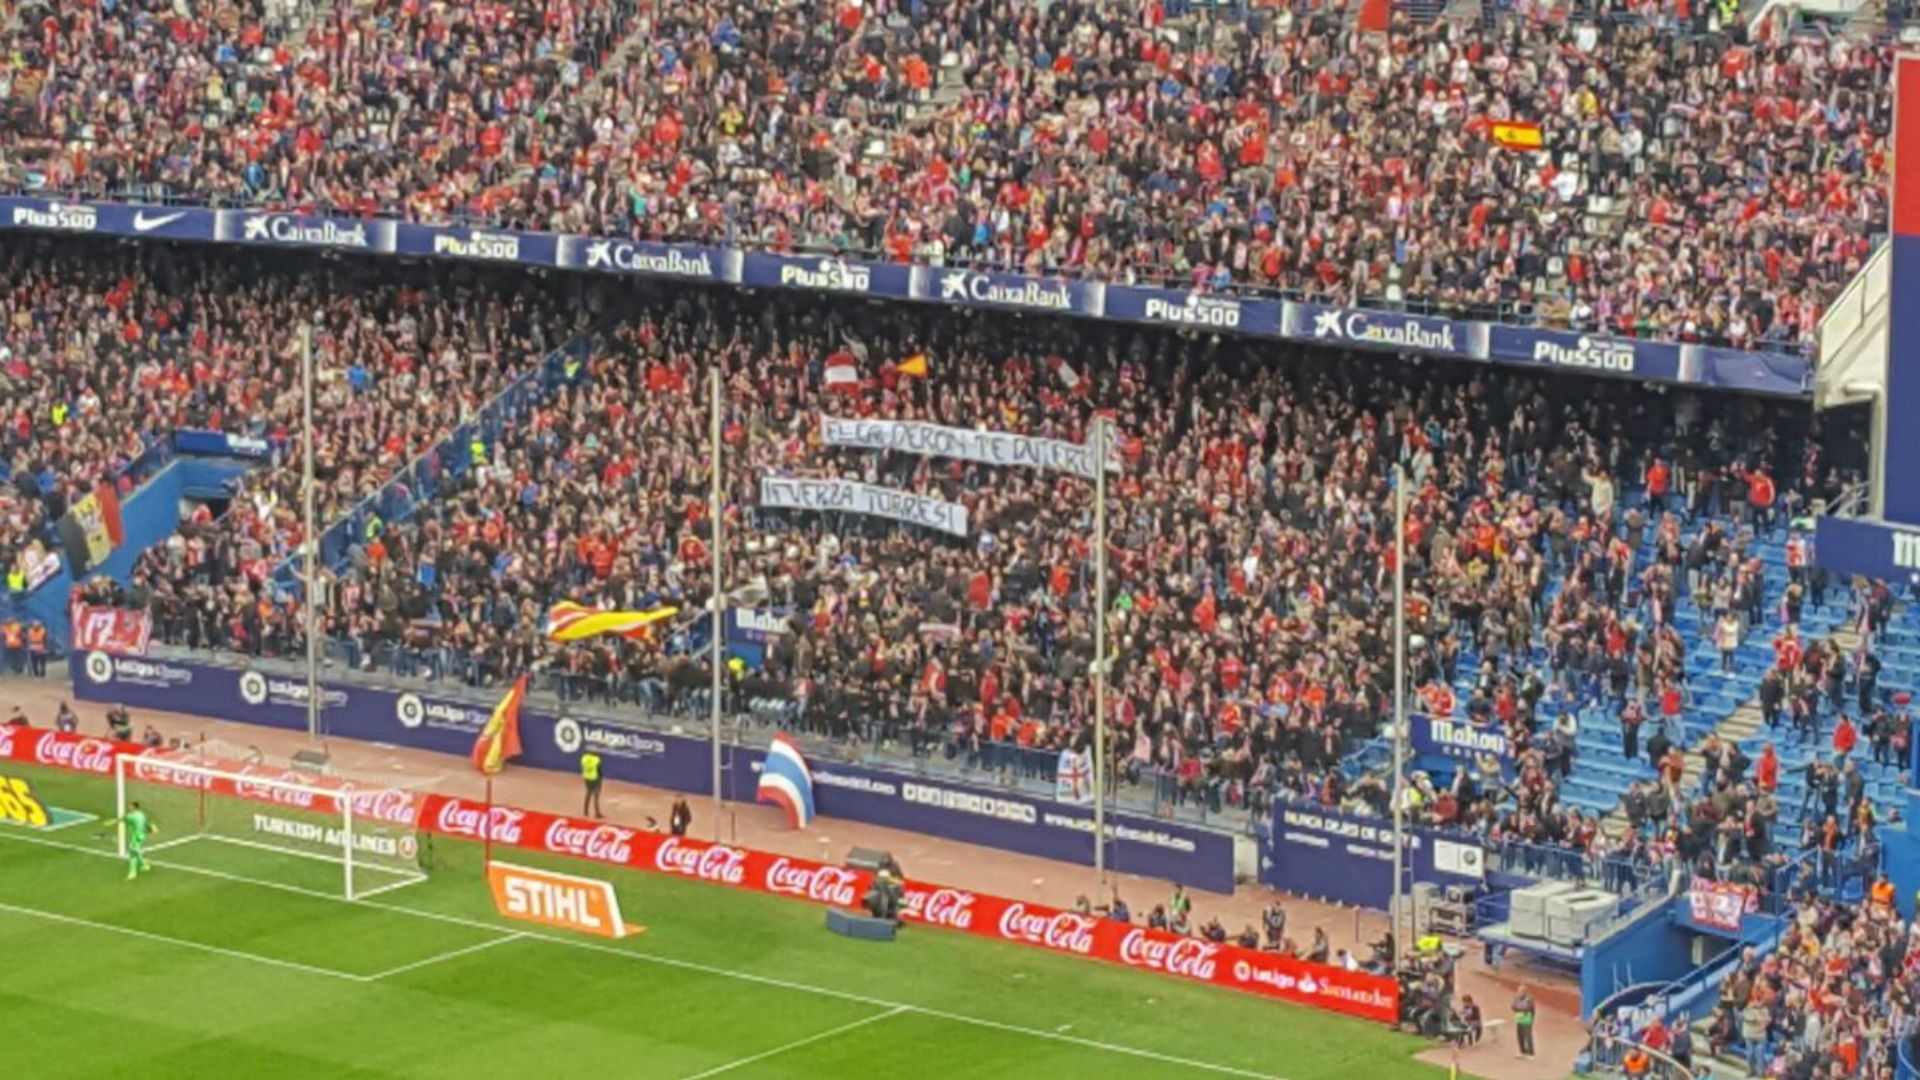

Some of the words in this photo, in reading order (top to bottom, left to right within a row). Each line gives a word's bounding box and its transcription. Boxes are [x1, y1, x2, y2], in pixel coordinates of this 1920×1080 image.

[13, 208, 96, 230] Plus500
[271, 216, 366, 247] CaixaBank
[434, 235, 518, 259] Plus500
[613, 245, 711, 275] CaixaBank
[970, 276, 1071, 308] CaixaBank
[1145, 299, 1239, 326] Plus500
[1345, 314, 1454, 350] CaixaBank
[1533, 343, 1635, 372] Plus500
[1431, 720, 1505, 755] Mahou
[0, 774, 47, 826] 65
[254, 814, 323, 842] TURKISH
[504, 875, 601, 929] STIHL
